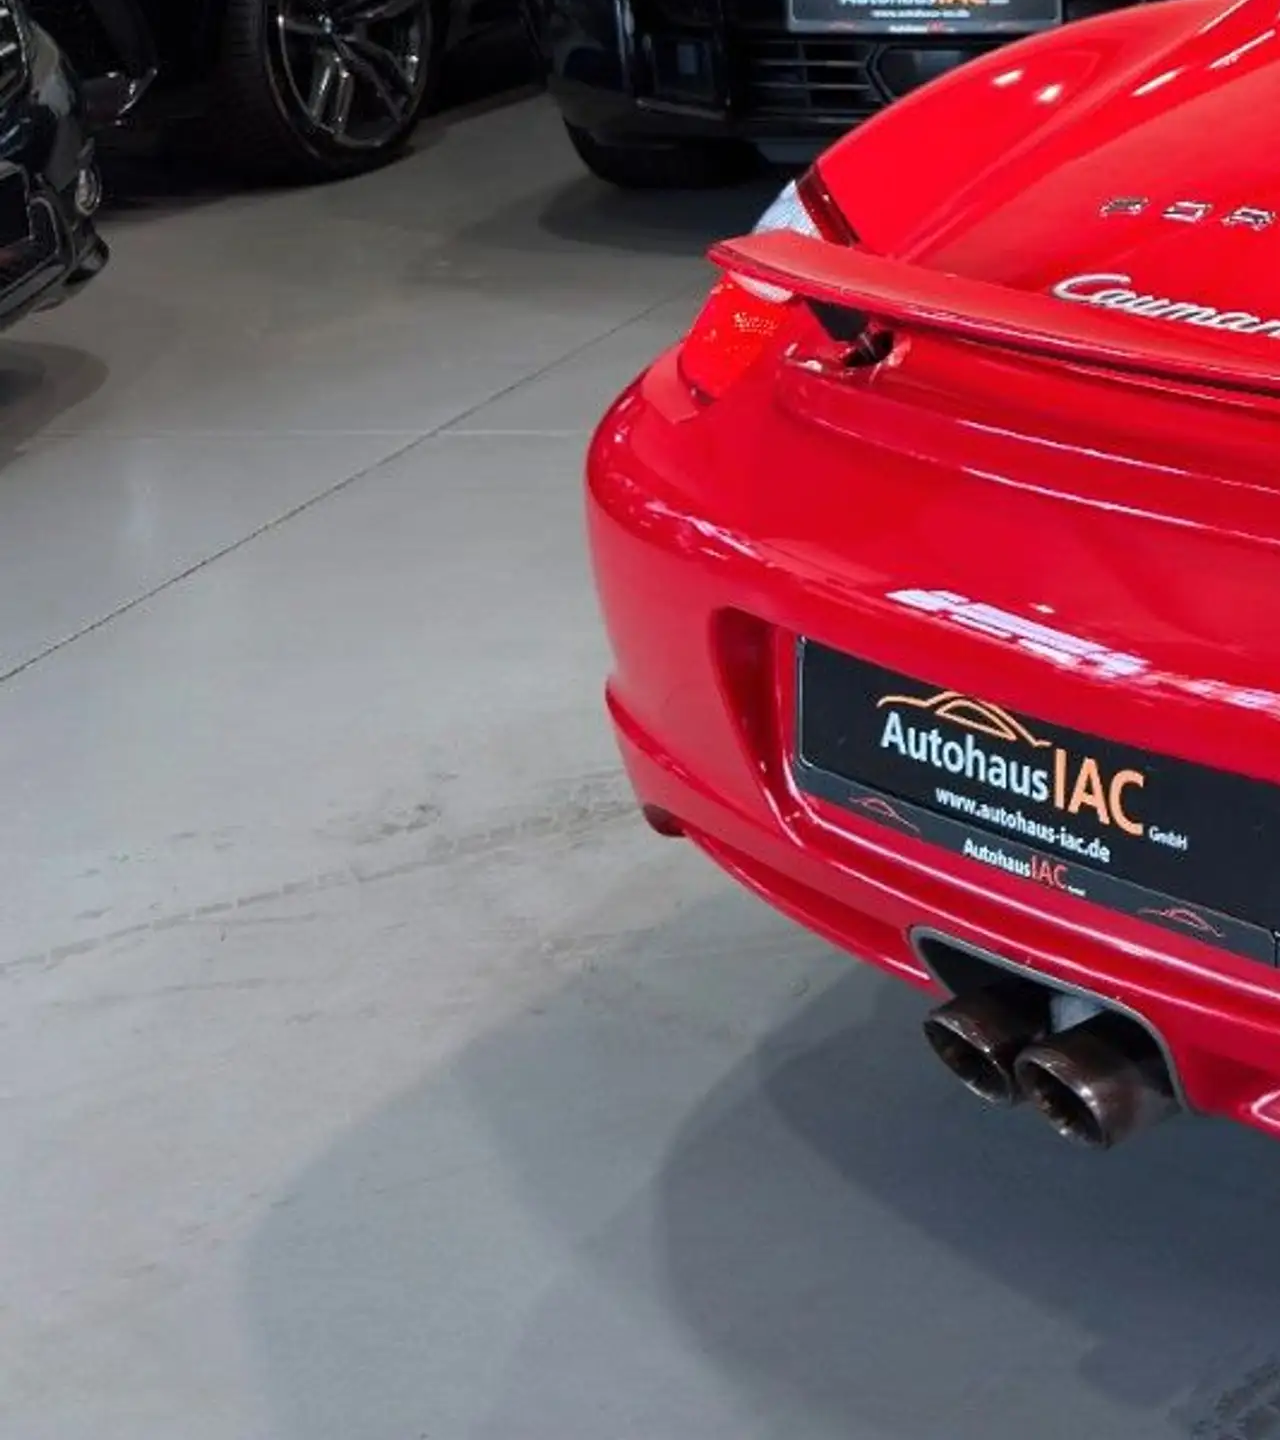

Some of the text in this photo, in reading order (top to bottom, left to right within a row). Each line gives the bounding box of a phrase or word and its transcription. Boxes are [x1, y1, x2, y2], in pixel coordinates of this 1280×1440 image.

[880, 711, 1189, 851] Autohaus IAC GmbH
[935, 786, 1111, 864] www.autohaus-iac.de
[962, 837, 1068, 890] Autohaus IAC
